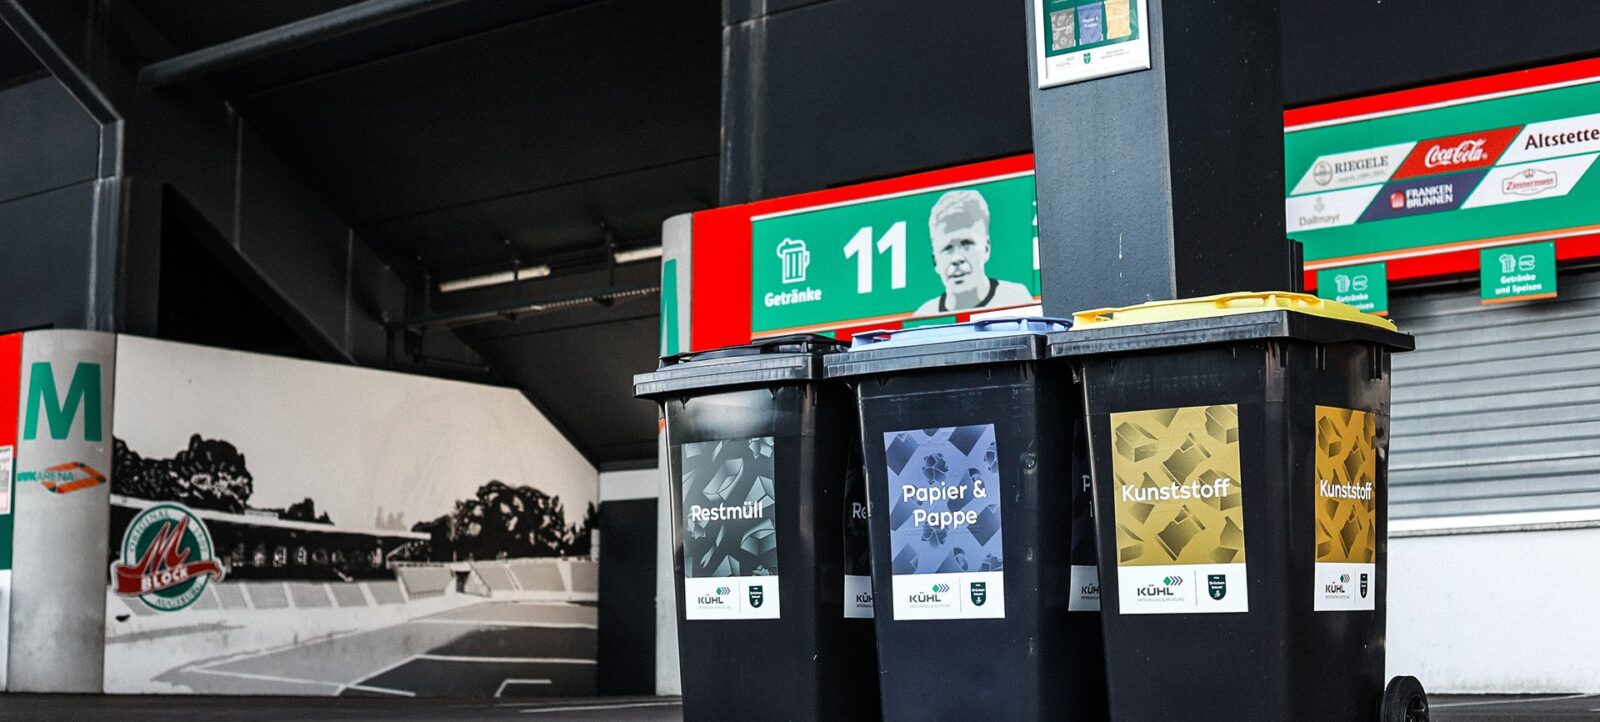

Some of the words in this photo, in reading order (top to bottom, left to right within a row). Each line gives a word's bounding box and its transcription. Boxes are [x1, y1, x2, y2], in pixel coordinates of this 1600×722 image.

[1335, 155, 1388, 174] RIEGELE
[1406, 184, 1453, 199] FRANKEN
[1506, 178, 1554, 191] Zimmermann
[1406, 194, 1453, 209] BRUNNEN
[1299, 214, 1340, 226] Dallmayr
[843, 221, 907, 294] 11
[1501, 273, 1536, 284] Getränke
[764, 287, 822, 307] Getränke
[1495, 286, 1511, 295] und
[1512, 283, 1543, 294] Speisen
[23, 362, 103, 442] M
[902, 482, 968, 506] Papier
[972, 479, 987, 499] &
[1121, 477, 1231, 502] Kunststoff
[1319, 479, 1372, 501] Kunststoff
[690, 500, 764, 522] Restmüll
[912, 509, 978, 530] Pappe
[140, 564, 190, 593] BLOCK
[1325, 581, 1346, 593] KÜHL
[909, 591, 941, 603] KÜHL
[1137, 584, 1174, 596] KÜHL
[697, 594, 724, 605] KÜHL
